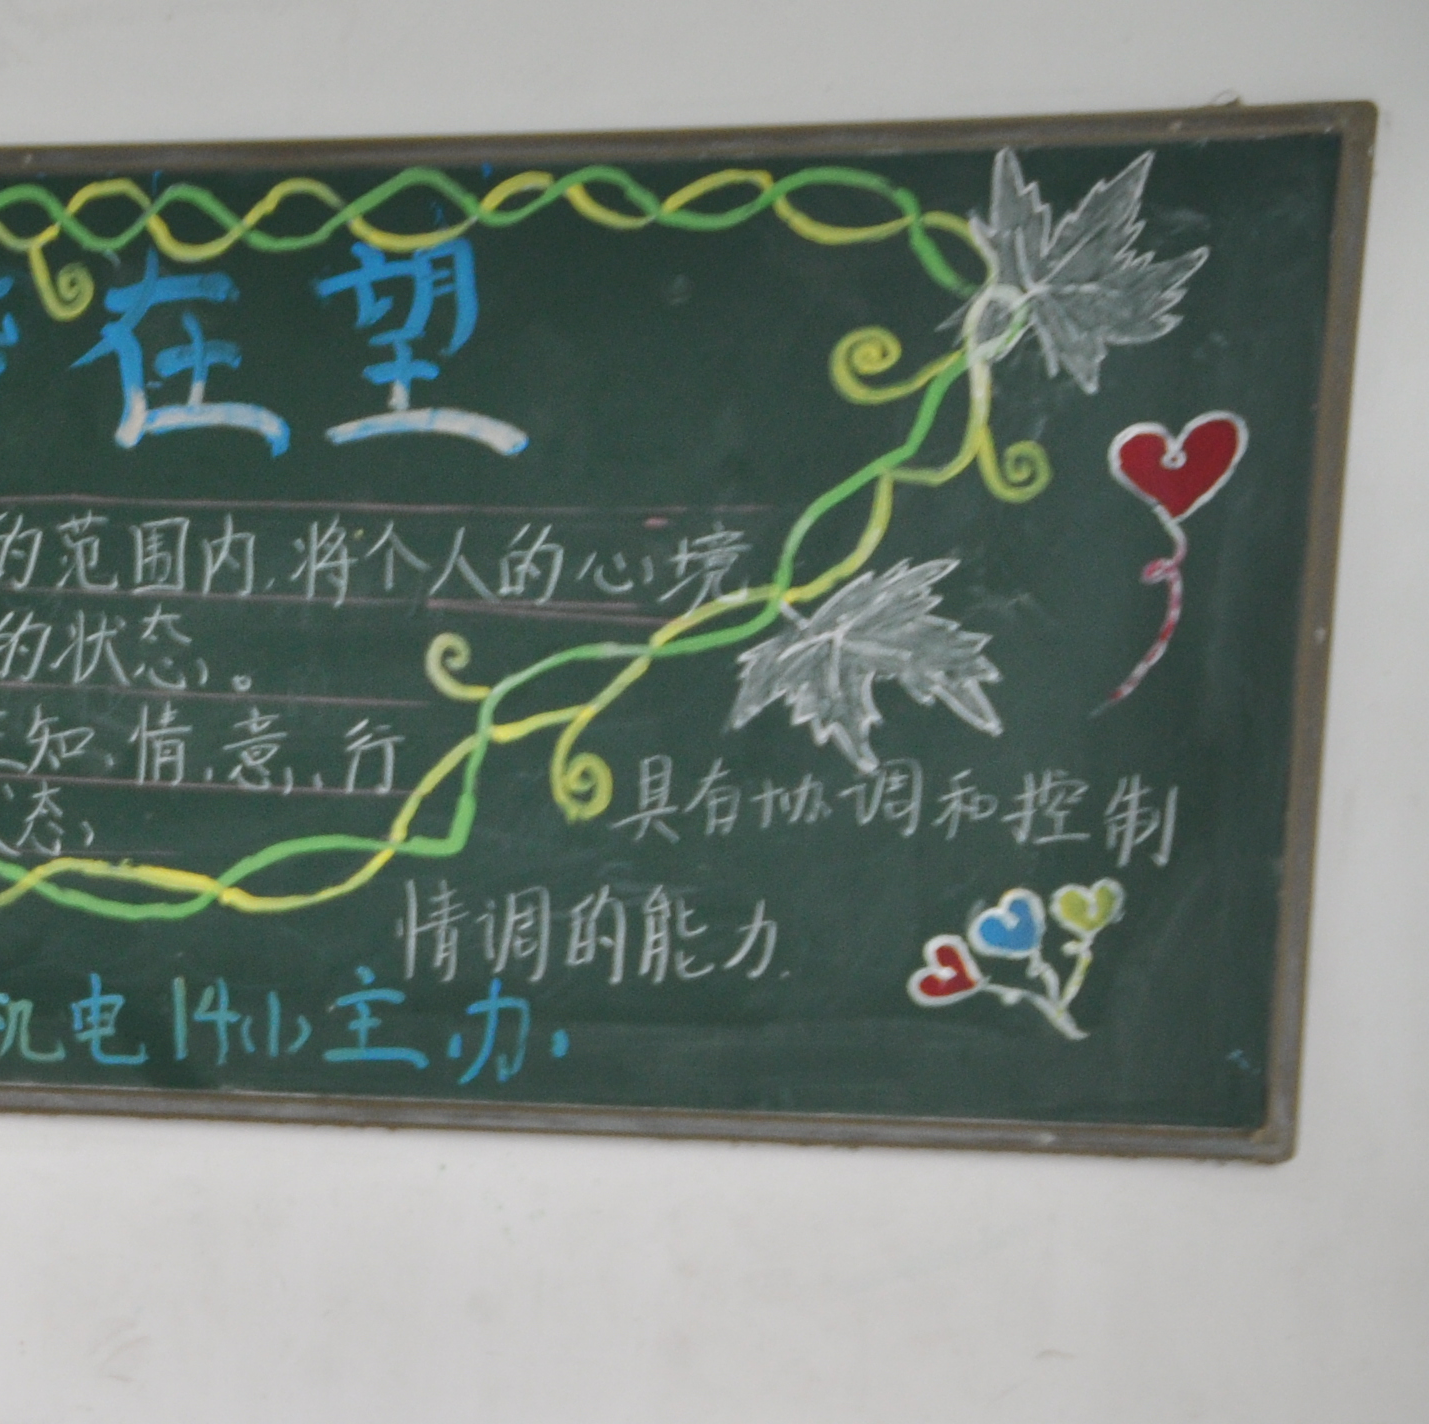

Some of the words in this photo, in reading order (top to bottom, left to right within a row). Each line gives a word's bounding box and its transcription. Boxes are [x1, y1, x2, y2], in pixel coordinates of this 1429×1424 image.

[609, 755, 1180, 868] 具有协调和控制
